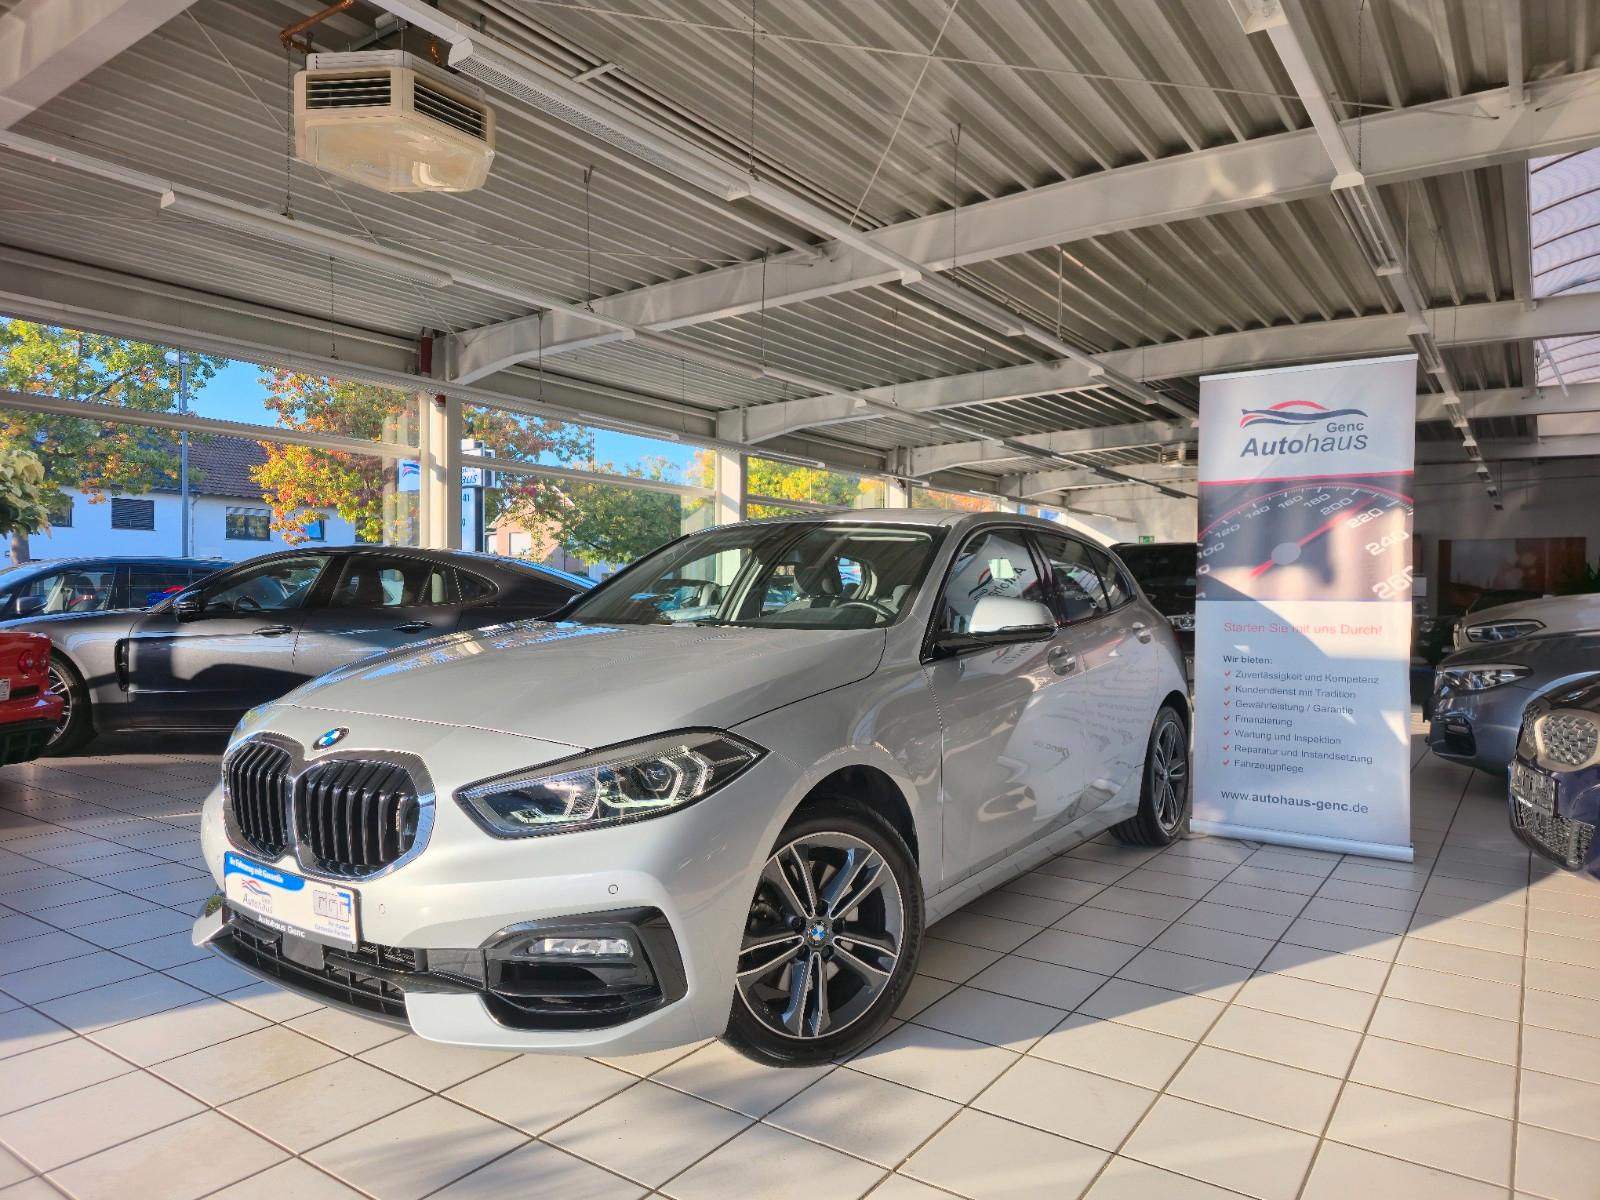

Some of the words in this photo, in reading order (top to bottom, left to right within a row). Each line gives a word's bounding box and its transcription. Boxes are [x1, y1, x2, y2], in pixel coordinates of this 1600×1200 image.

[1326, 422, 1364, 433] Genc
[1240, 433, 1368, 458] Autohaus
[1278, 495, 1303, 509] 160
[1303, 494, 1331, 508] 180
[1320, 497, 1353, 516] 200
[1244, 505, 1271, 520] 140
[1347, 507, 1384, 529] 220
[1214, 523, 1240, 538] 120
[1365, 528, 1410, 556] 240
[1224, 622, 1265, 633] Starten
[1269, 624, 1289, 634] Sie
[1292, 624, 1310, 634] mit
[1314, 625, 1337, 635] uns
[1340, 624, 1383, 636] Durch!
[1223, 655, 1238, 664] Wir
[1241, 656, 1273, 665] bieten:
[1235, 670, 1303, 682] Zuverlässigkeit
[1305, 672, 1323, 682] und
[1325, 674, 1380, 686] Kompetenz
[1235, 685, 1297, 696] Kundendienst
[1299, 687, 1313, 697] mit
[1315, 688, 1356, 699] Tradition
[1235, 700, 1305, 714] Gewährleistung
[1313, 704, 1354, 715] Garantie
[1235, 715, 1293, 727] Finanzierung
[1235, 729, 1272, 741] Wartung
[1274, 732, 1291, 742] und
[1294, 733, 1342, 745] Inspektion
[1234, 744, 1279, 757] Reparatur
[1281, 747, 1298, 757] und
[1301, 748, 1373, 765] Instandsetzung
[1234, 759, 1304, 773] Fahrzeugpflege
[1220, 790, 1369, 814] www.autohaus-genc.de
